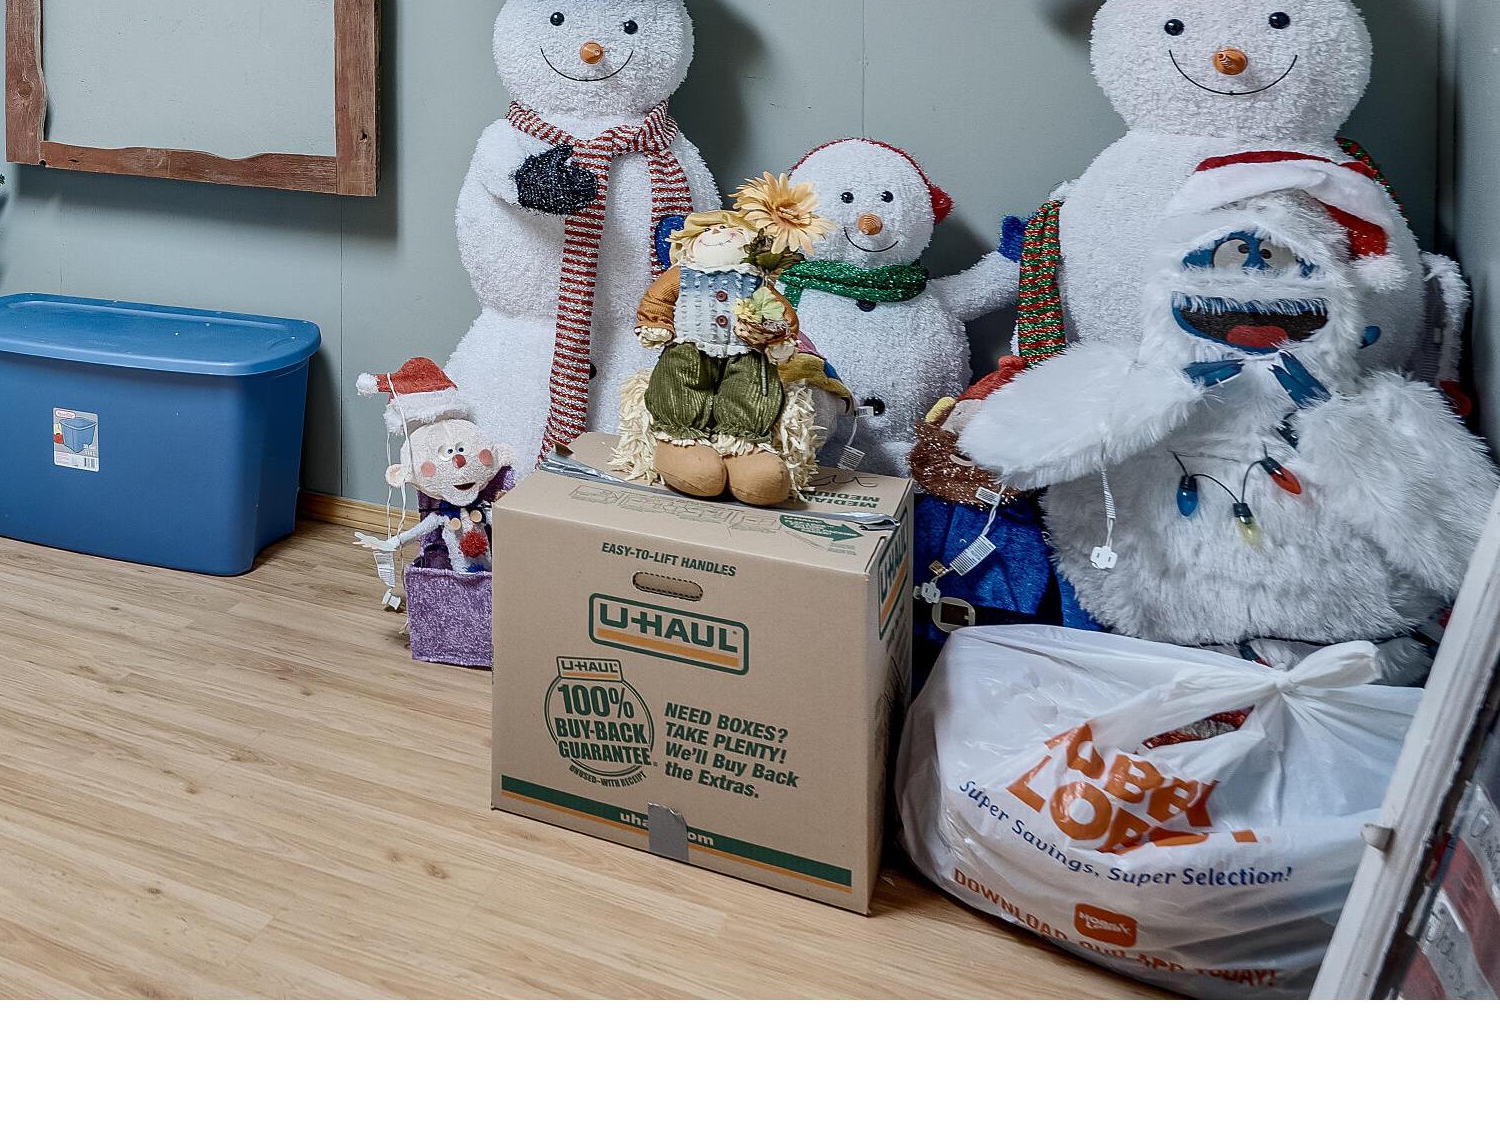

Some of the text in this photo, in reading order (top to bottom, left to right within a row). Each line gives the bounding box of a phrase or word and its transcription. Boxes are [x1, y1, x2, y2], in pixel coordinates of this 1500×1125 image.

[601, 542, 737, 577] EASY-TO-LIFT HANDLES
[599, 602, 739, 654] U-HAUL
[561, 659, 619, 674] U-HAUL
[557, 683, 634, 719] 100%
[554, 716, 648, 744] BUY-BACK
[664, 702, 789, 744] NEED BOXES?
[558, 740, 651, 766] GUARANTEE
[665, 722, 788, 764] TAKE PLENTY!
[621, 770, 647, 788] RECEIPT
[664, 760, 760, 798] the Extras.
[665, 742, 800, 788] We'll Buy Back
[1044, 723, 1220, 827] OBBY
[959, 780, 1293, 887] Super Savings, Super Selection!
